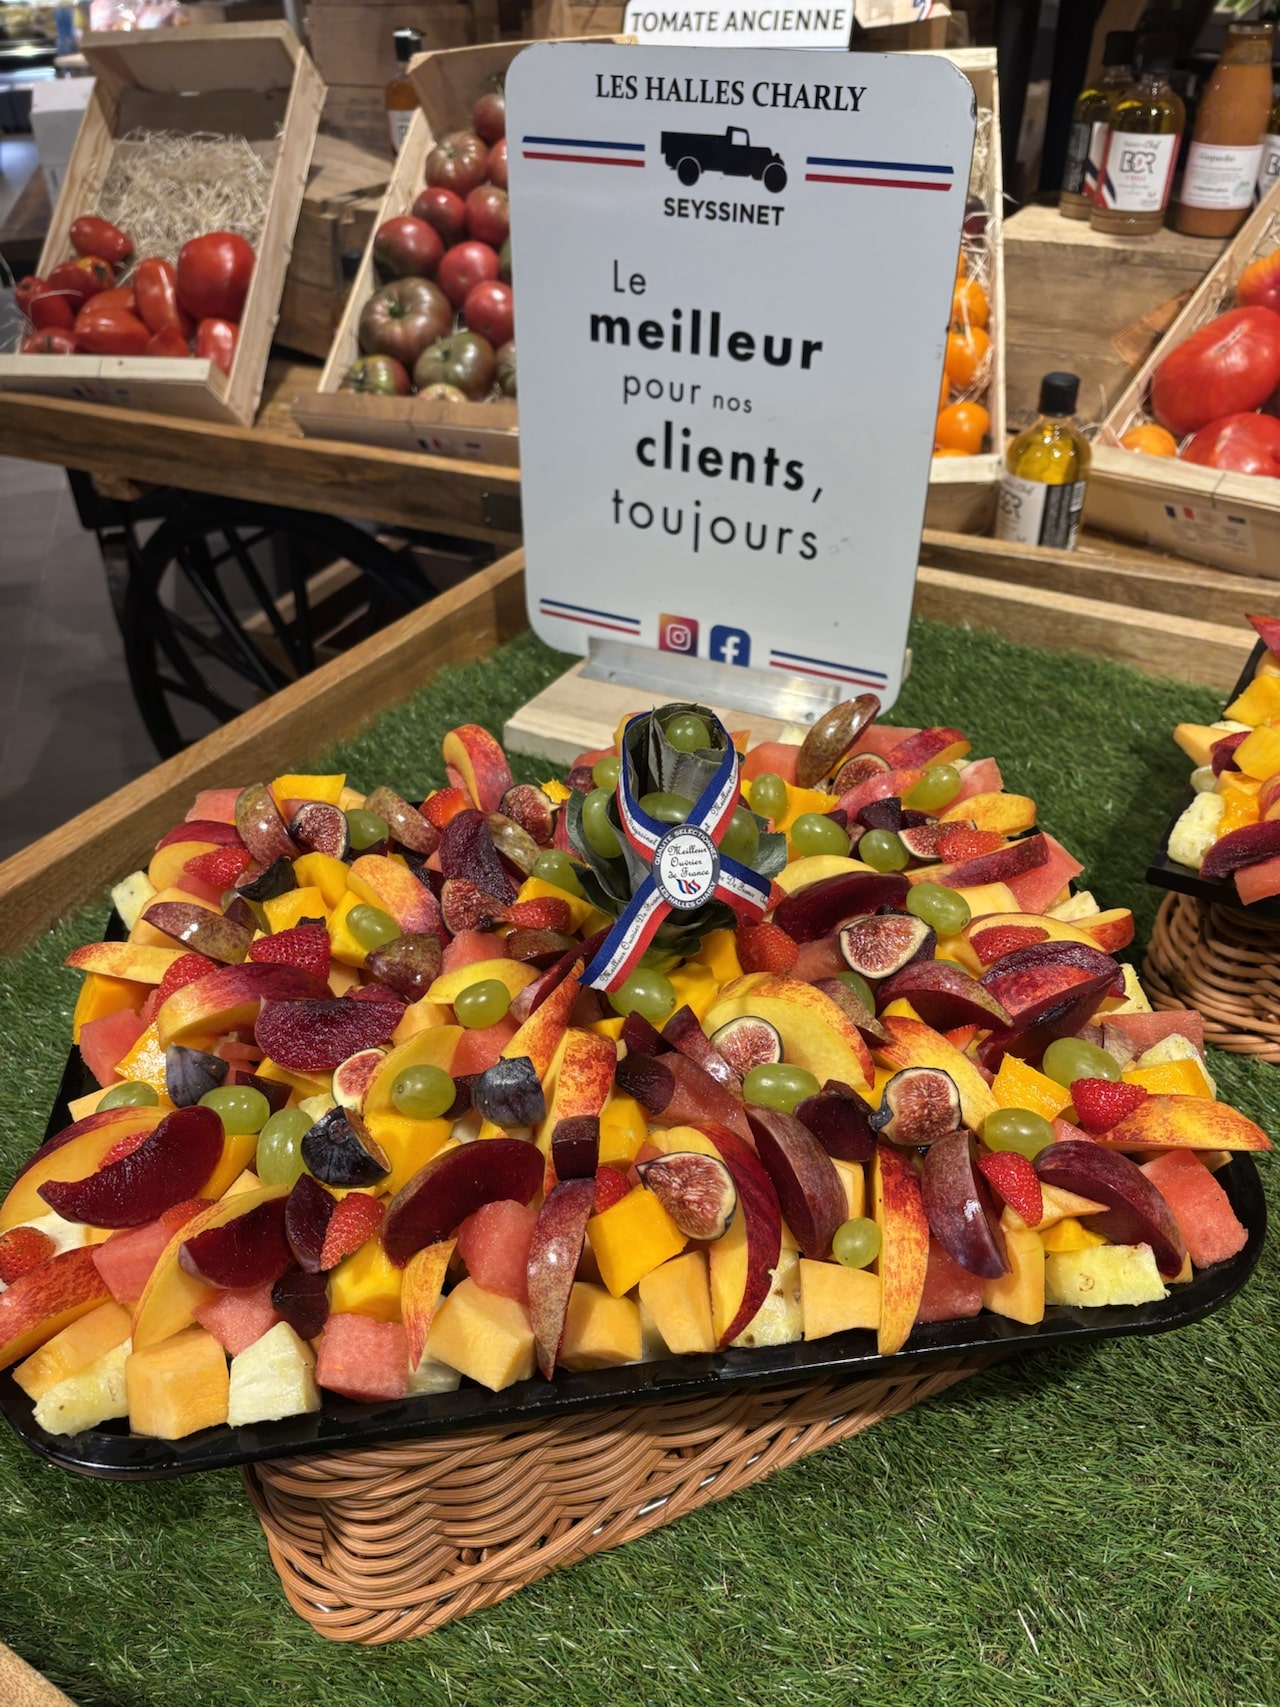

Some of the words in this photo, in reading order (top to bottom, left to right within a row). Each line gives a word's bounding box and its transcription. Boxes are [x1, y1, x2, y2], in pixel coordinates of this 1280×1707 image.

[632, 10, 719, 33] TOMATE
[724, 8, 846, 32] ANCIENNE
[595, 73, 638, 100] LES
[644, 76, 745, 107] HALLES
[752, 81, 867, 112] CHARLY
[663, 197, 785, 227] SEYSSINET
[613, 259, 647, 296] Le
[590, 307, 823, 370] meilleur
[623, 375, 702, 405] pour
[712, 394, 753, 414] nos
[635, 420, 823, 503] clients,
[612, 489, 818, 560] toujours
[667, 844, 707, 856] Meilleur
[671, 857, 702, 867] Ouvrier
[681, 867, 709, 878] France
[660, 885, 670, 899] LES
[669, 896, 696, 908] HALLES
[696, 881, 717, 904] CHARLY
